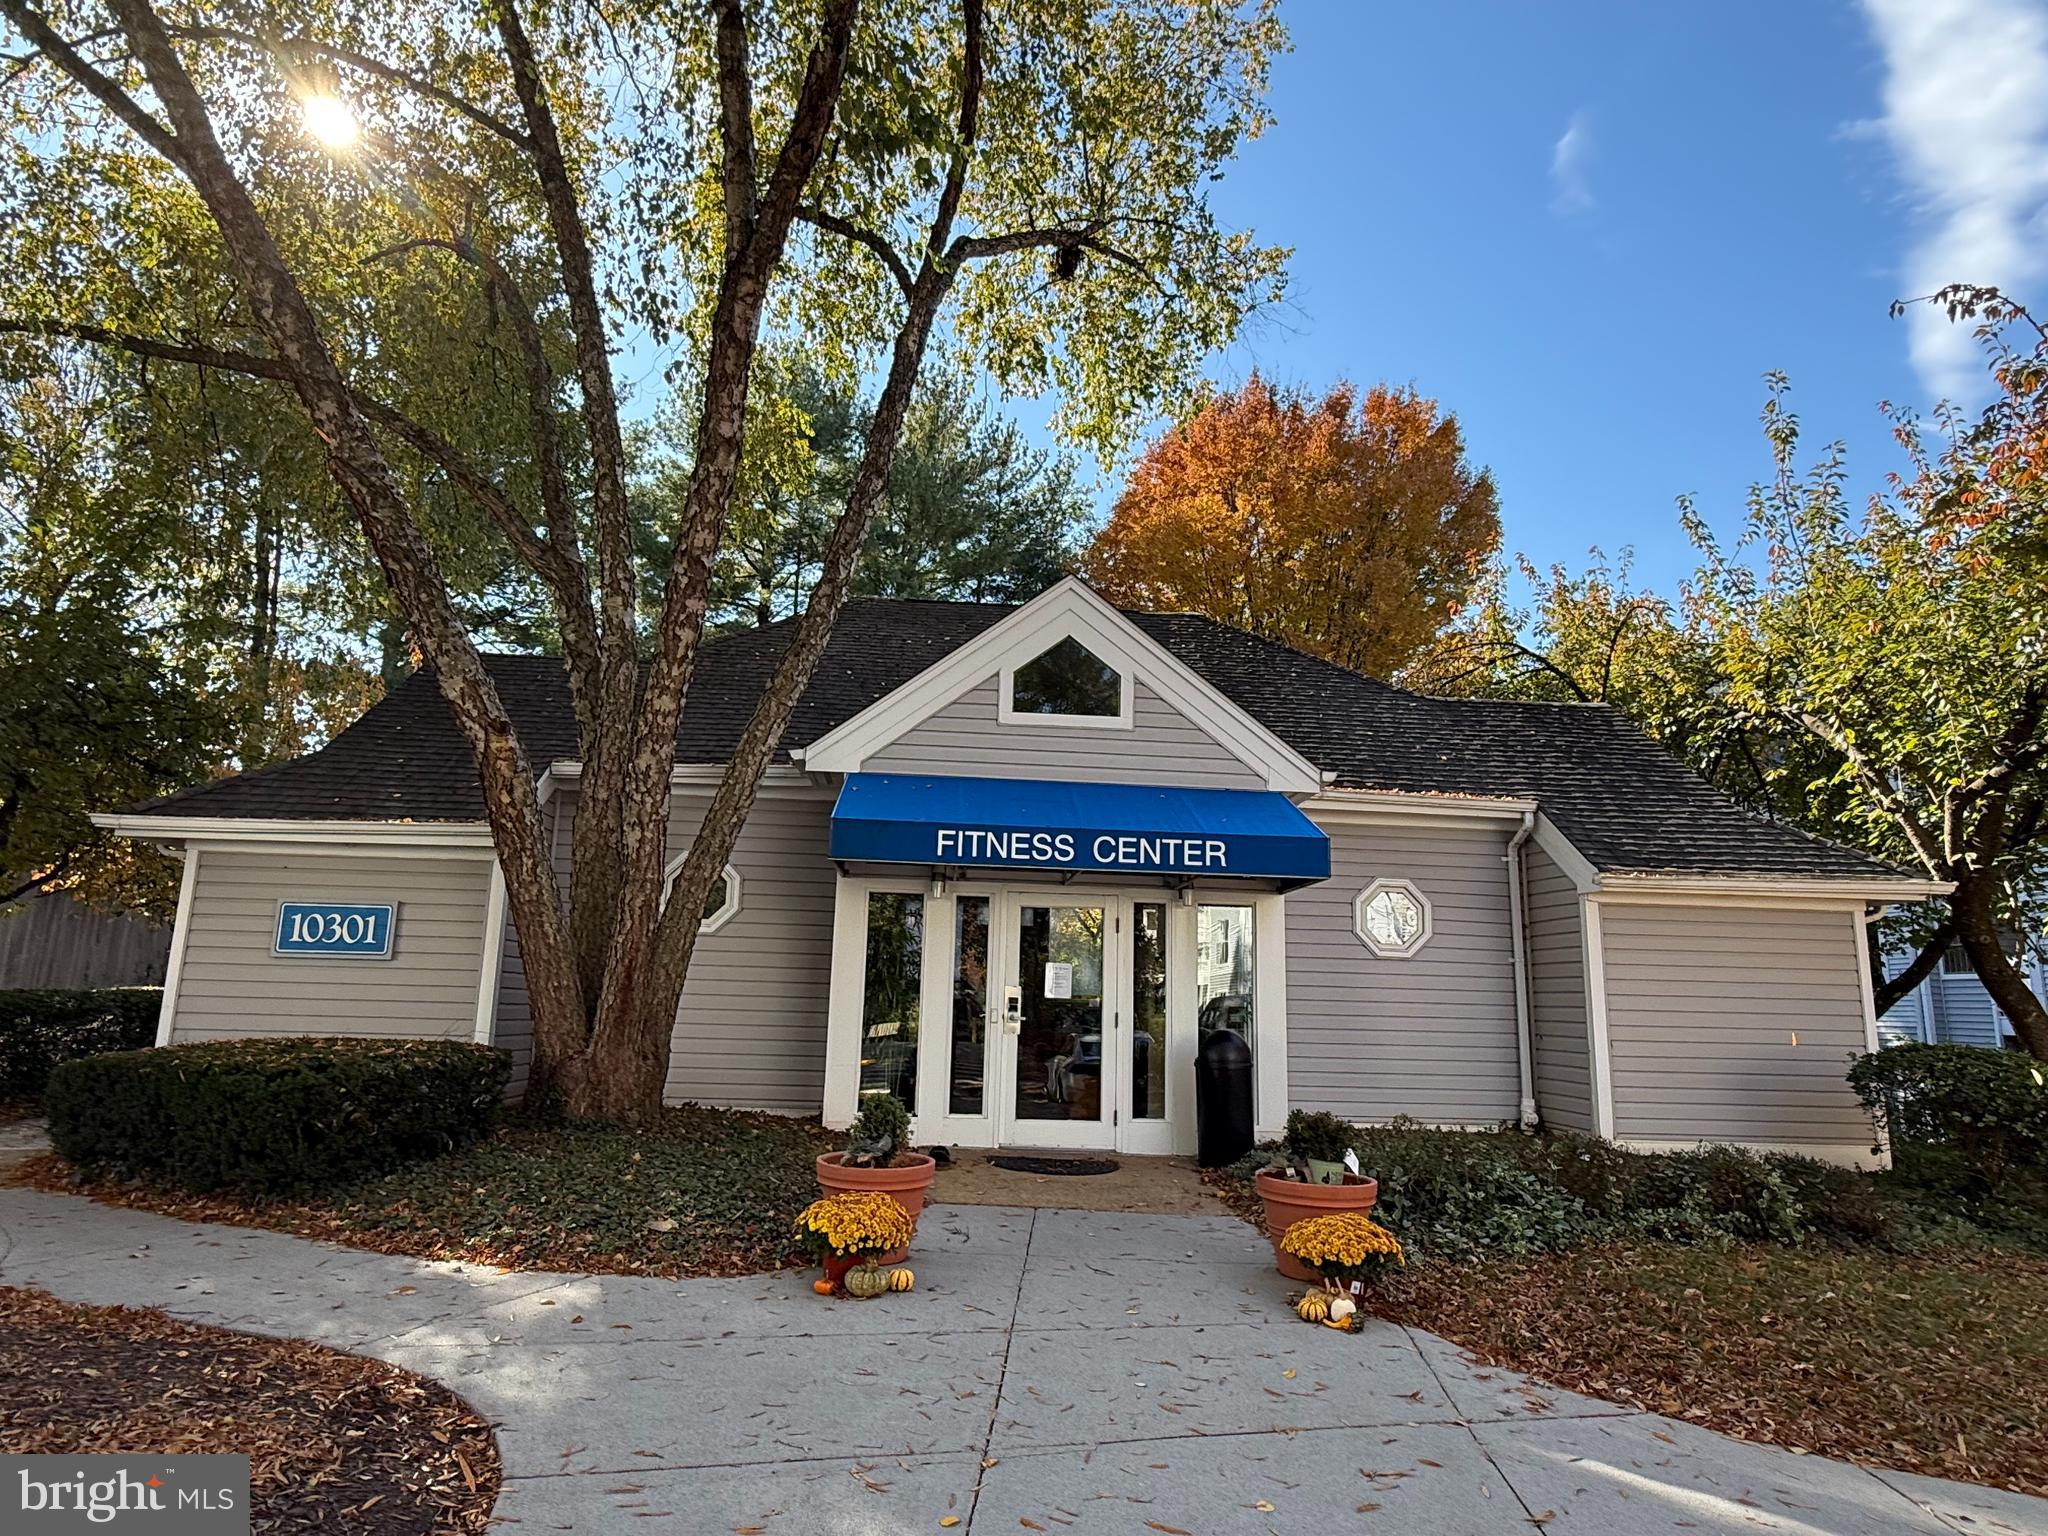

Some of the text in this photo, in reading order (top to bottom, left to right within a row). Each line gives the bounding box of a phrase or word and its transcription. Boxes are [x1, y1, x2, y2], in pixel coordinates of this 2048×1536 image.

[937, 830, 1227, 867] FITNESS CENTER
[288, 913, 377, 944] 10301
